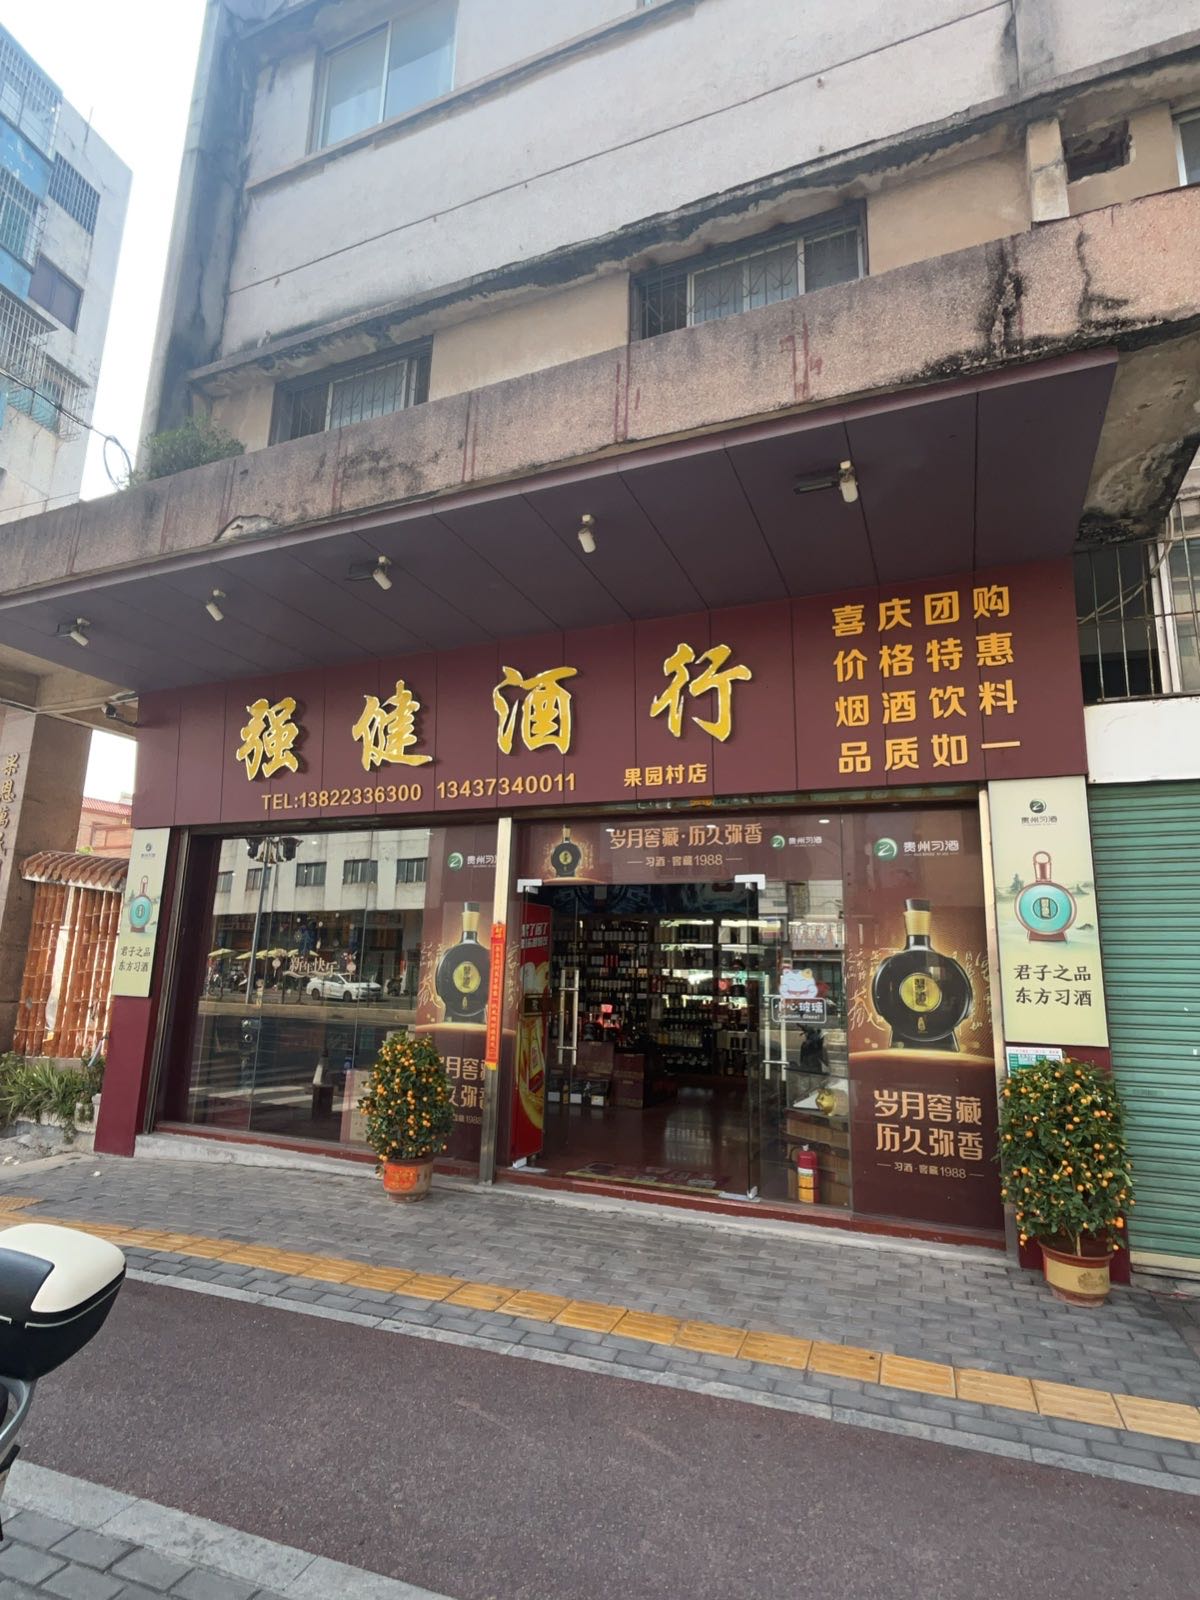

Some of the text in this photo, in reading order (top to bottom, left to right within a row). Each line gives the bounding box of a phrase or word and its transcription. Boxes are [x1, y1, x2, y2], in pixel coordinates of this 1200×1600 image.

[832, 584, 1011, 637] 喜庆团购
[833, 631, 1015, 683] 价格特惠
[236, 643, 752, 782] 强健酒行
[835, 679, 1018, 728] 烟酒饮料
[838, 733, 1021, 774] 品质如一
[623, 763, 708, 788] 果园村店
[261, 772, 577, 811] TEL:13822336300 13437340011
[903, 840, 959, 853] 贵州习酒
[467, 855, 497, 865] 贵州习
[120, 946, 151, 957] 君子之品
[118, 961, 149, 973] 东方习酒
[1014, 964, 1092, 982] 君子之品
[774, 1001, 823, 1014] 小心玻璃
[1015, 987, 1092, 1007] 东方习酒
[439, 1056, 485, 1081] 月窖
[873, 1089, 982, 1126] 岁月窖藏
[875, 1123, 983, 1161] 历久弥香
